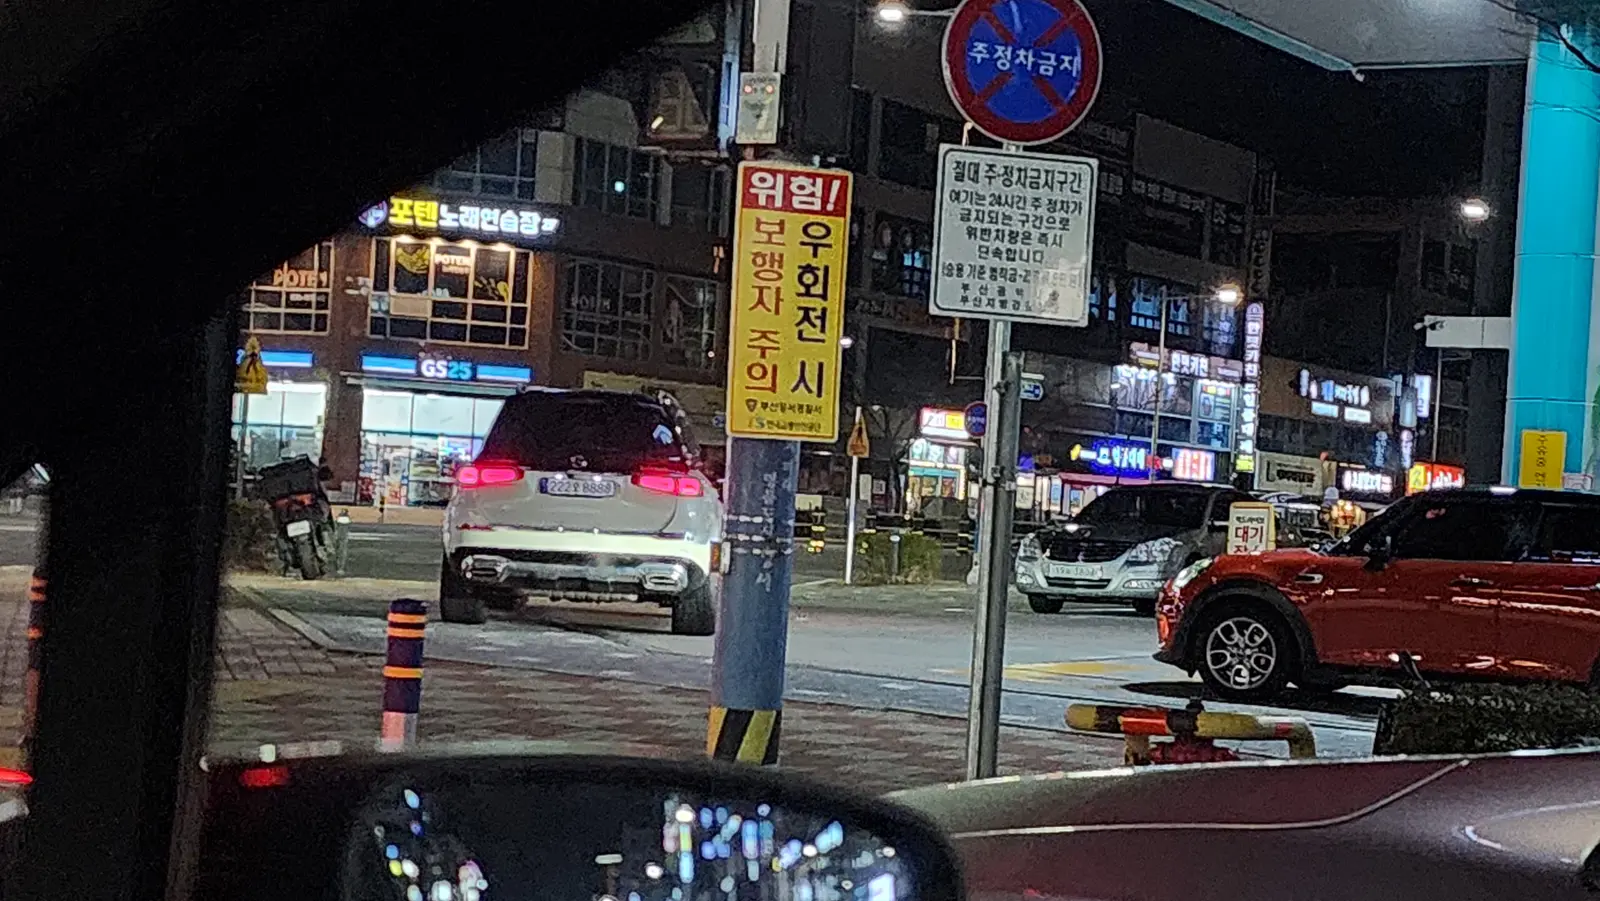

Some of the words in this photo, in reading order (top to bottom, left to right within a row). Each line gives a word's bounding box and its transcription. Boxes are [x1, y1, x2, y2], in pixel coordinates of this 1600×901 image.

[967, 41, 1078, 78] 주정차금지
[952, 160, 980, 185] 절대
[749, 171, 841, 212] 위험!
[949, 189, 986, 207] 여기는
[988, 192, 1027, 211] 24시간
[959, 208, 1013, 227] 금지되는
[1018, 213, 1071, 231] 구간으로
[965, 225, 1032, 246] 위반차량은
[1038, 233, 1063, 248] 즉시
[748, 216, 786, 316] 보행자
[795, 221, 833, 344] 우회전
[420, 358, 473, 381] GS25
[744, 328, 781, 395] 주의
[790, 360, 824, 398] 시
[1235, 525, 1264, 543] 대기
